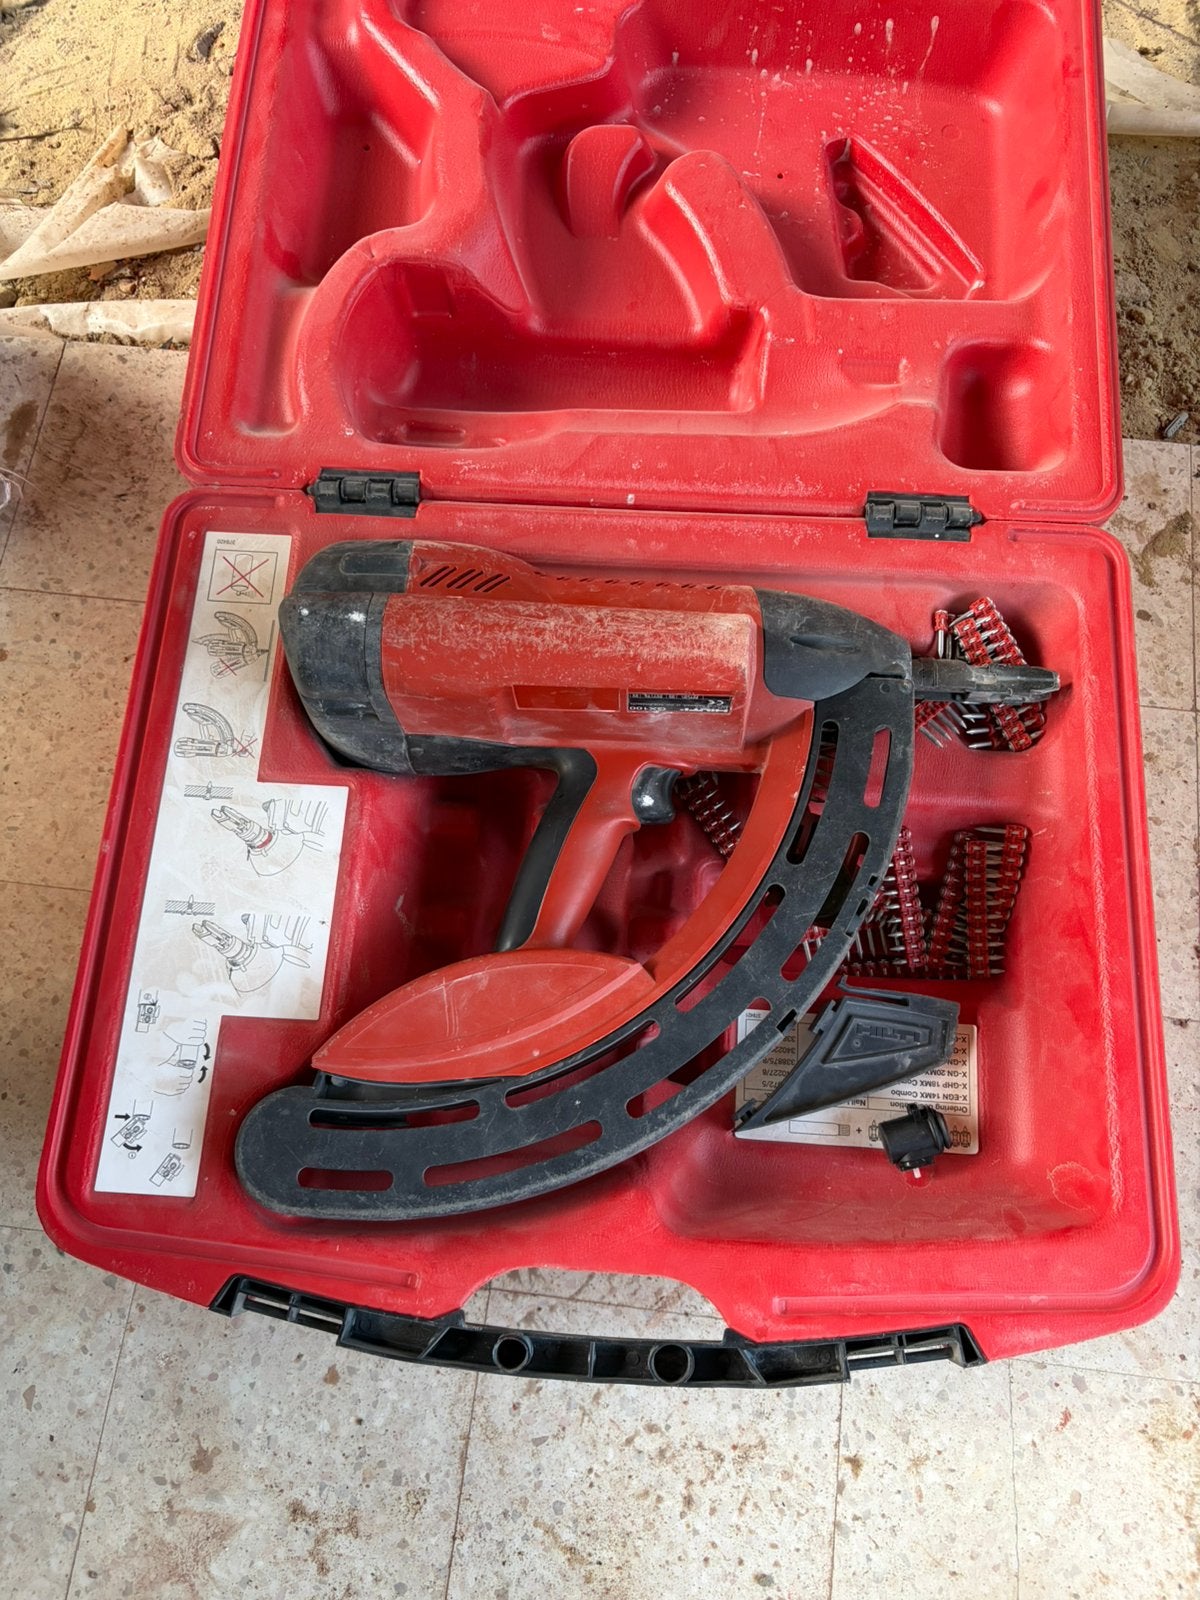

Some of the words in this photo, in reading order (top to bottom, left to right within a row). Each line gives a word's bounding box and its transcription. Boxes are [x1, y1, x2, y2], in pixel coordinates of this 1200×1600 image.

[856, 1022, 921, 1043] HILTI
[947, 1070, 968, 1078] X-GN
[919, 1079, 940, 1088] 18MX
[942, 1081, 968, 1090] X-GHP
[890, 1089, 918, 1099] Combo
[919, 1091, 940, 1100] 14MX
[942, 1093, 968, 1102] X-EGN
[935, 1104, 968, 1113] Ordering
